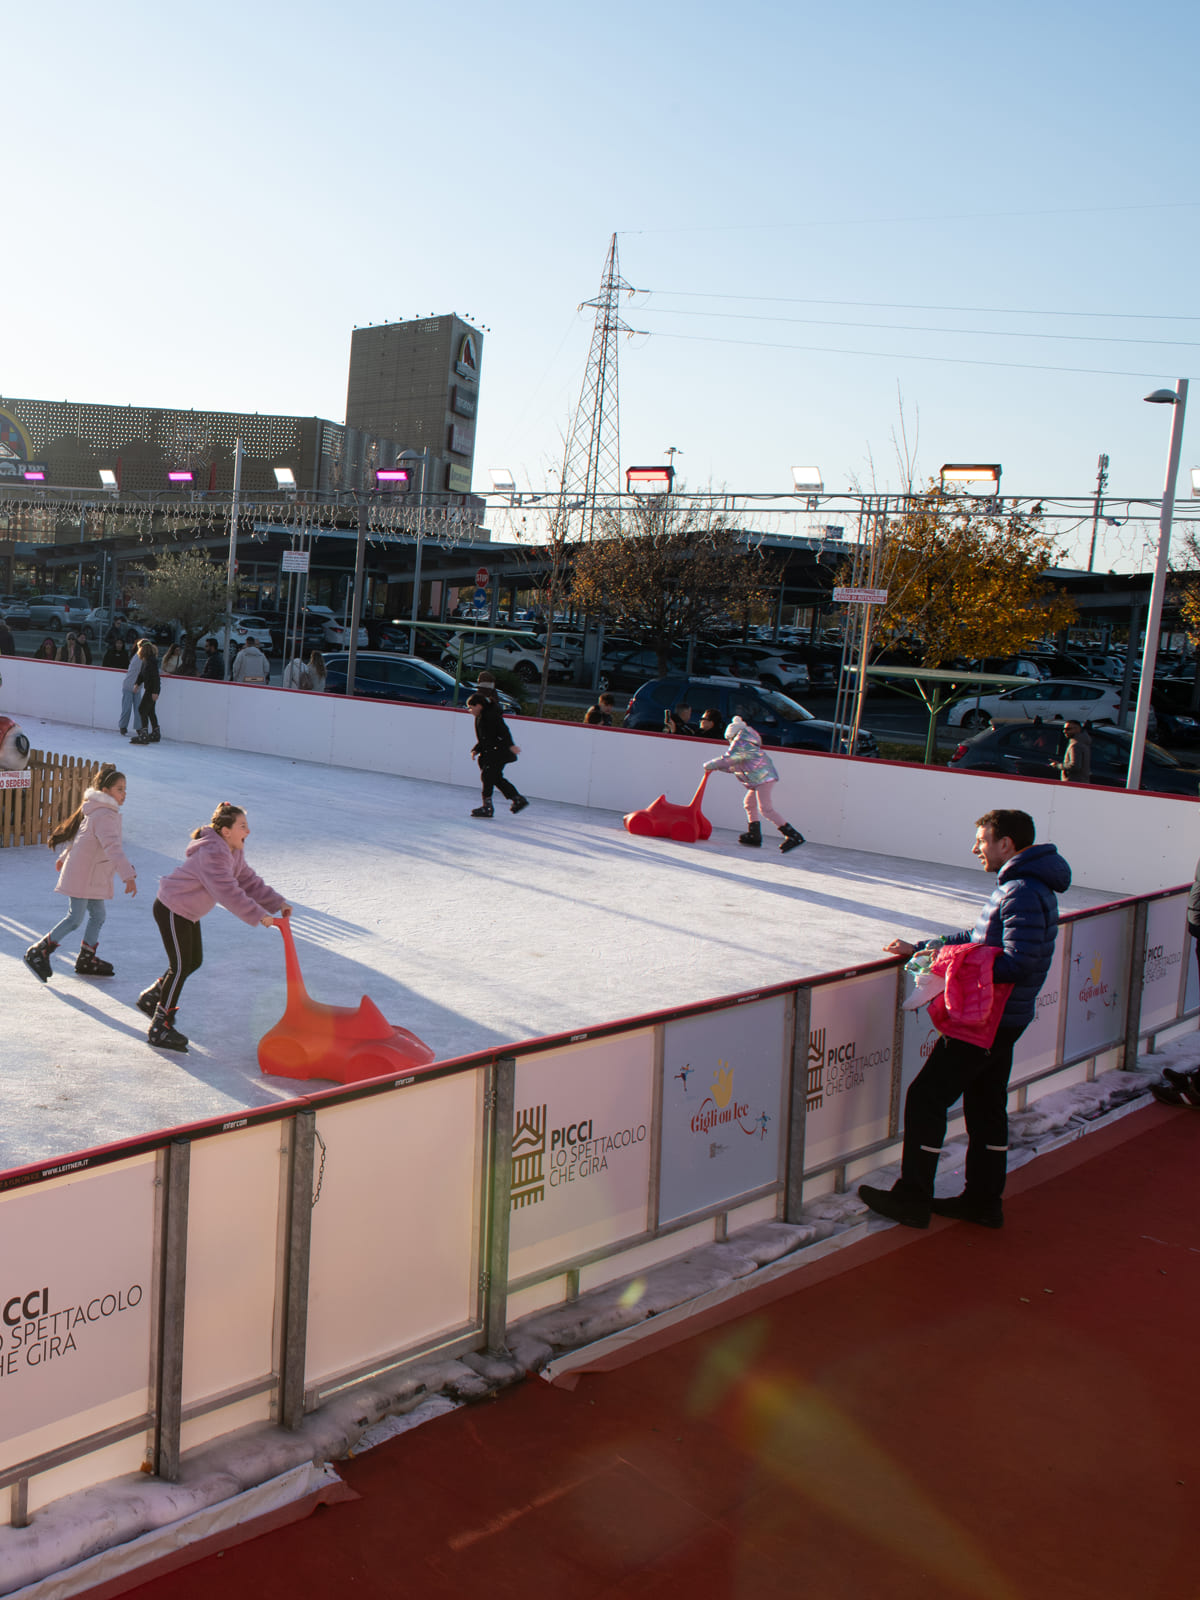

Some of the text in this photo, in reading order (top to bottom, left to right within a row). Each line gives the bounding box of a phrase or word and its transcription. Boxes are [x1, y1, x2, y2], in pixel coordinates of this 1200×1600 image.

[5, 778, 30, 788] SEDERSI
[827, 1047, 891, 1082] LO SPETTACOLO
[828, 1042, 856, 1067] PICCI
[825, 1071, 864, 1097] CHE GIRA
[690, 1098, 717, 1134] Gigli
[718, 1108, 732, 1125] on
[550, 1124, 647, 1170] LO SPETTACOLO
[551, 1119, 593, 1151] PICCI
[42, 1158, 89, 1177] WWW.LEITNER.IT
[549, 1155, 609, 1187] CHE GIRA
[11, 1284, 143, 1350] SPETTACOLO
[26, 1332, 77, 1366] GIRA
